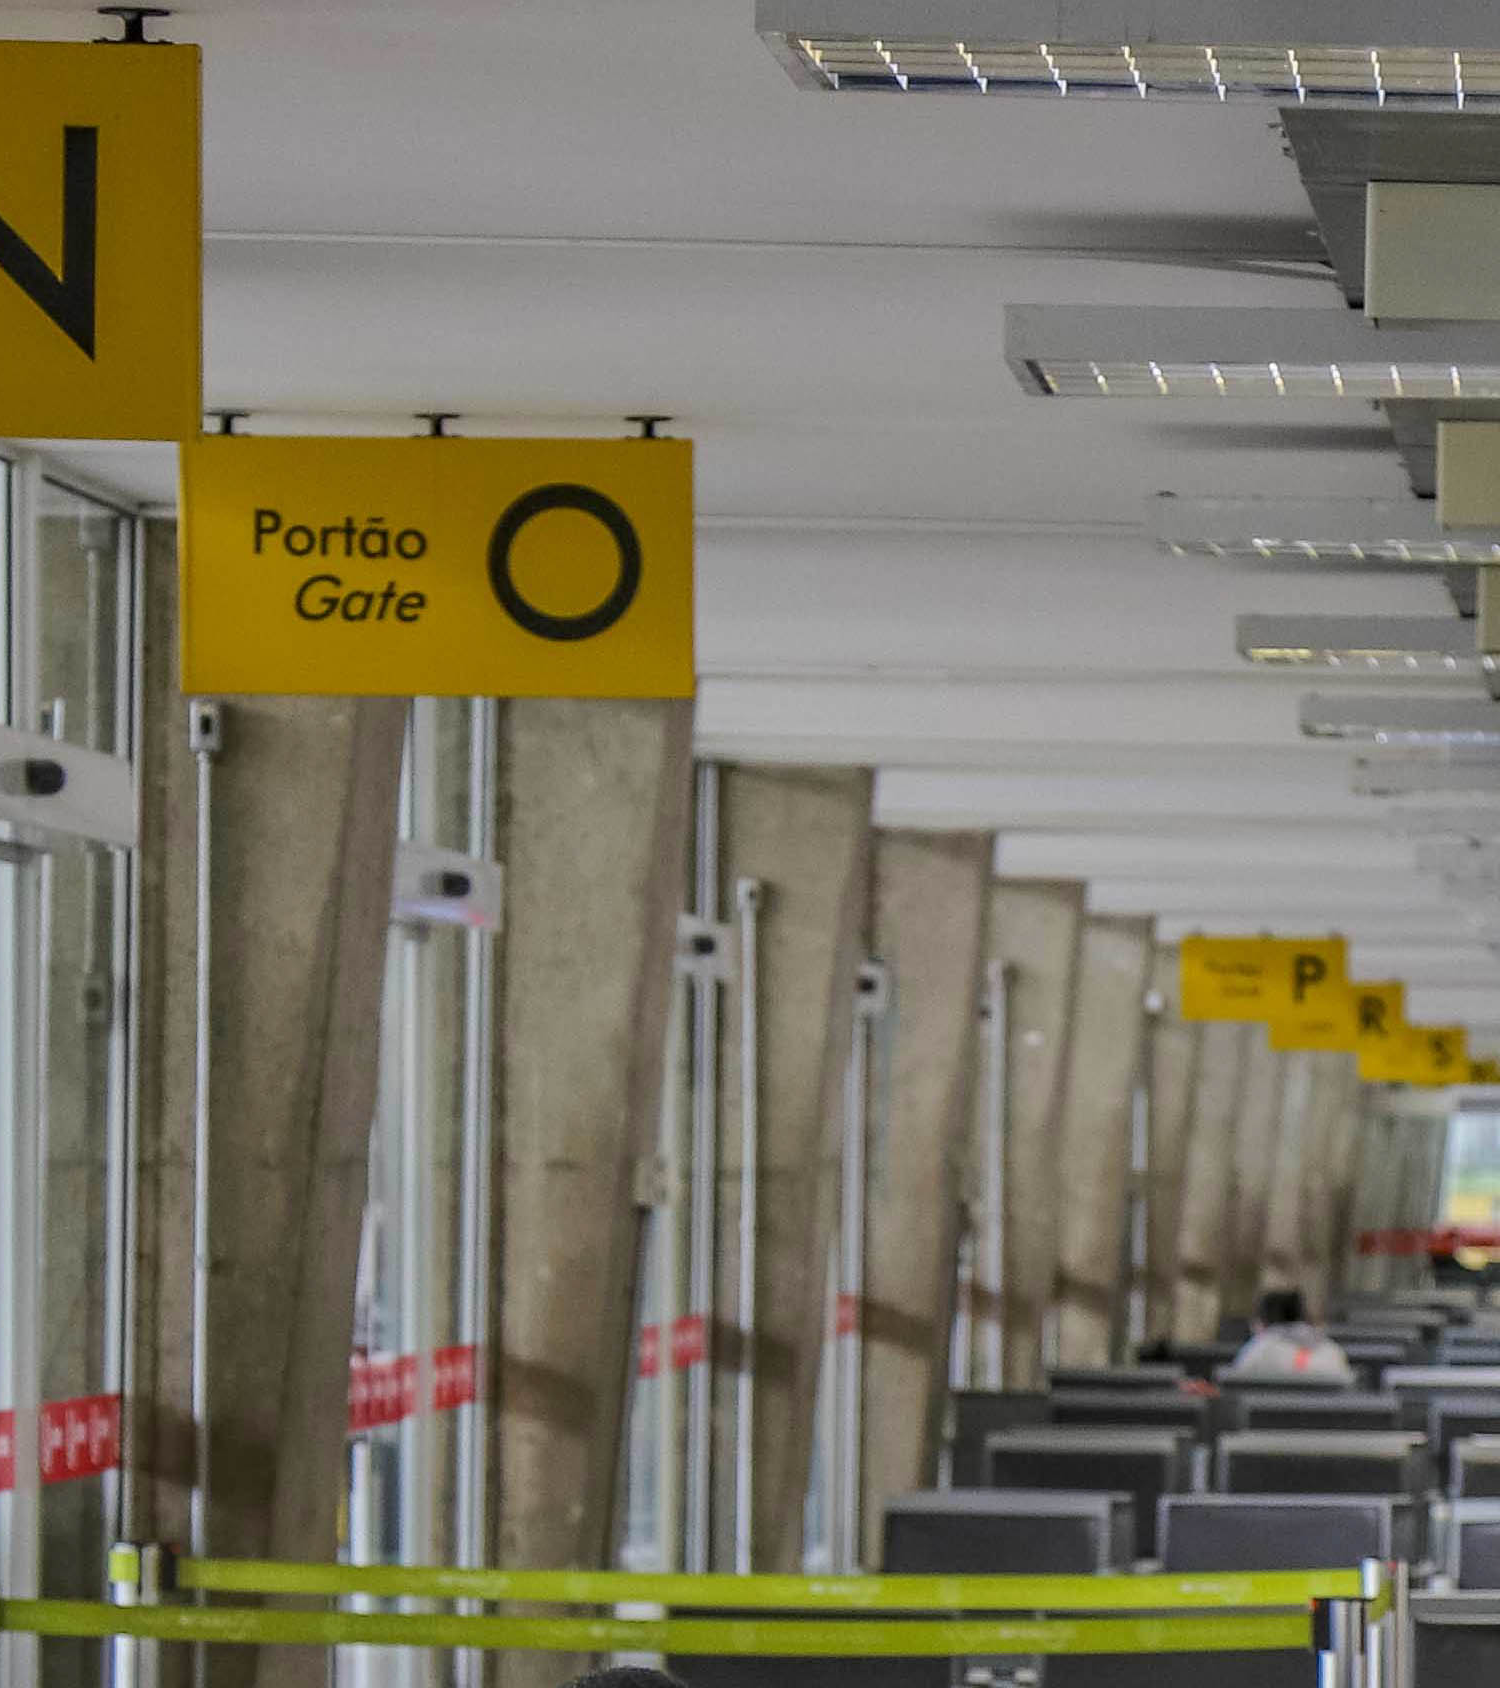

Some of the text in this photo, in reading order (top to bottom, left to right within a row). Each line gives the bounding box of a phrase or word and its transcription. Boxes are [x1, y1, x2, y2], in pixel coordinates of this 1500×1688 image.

[252, 483, 642, 642] Portão O
[294, 573, 427, 624] Gate
[1292, 952, 1328, 1003] P
